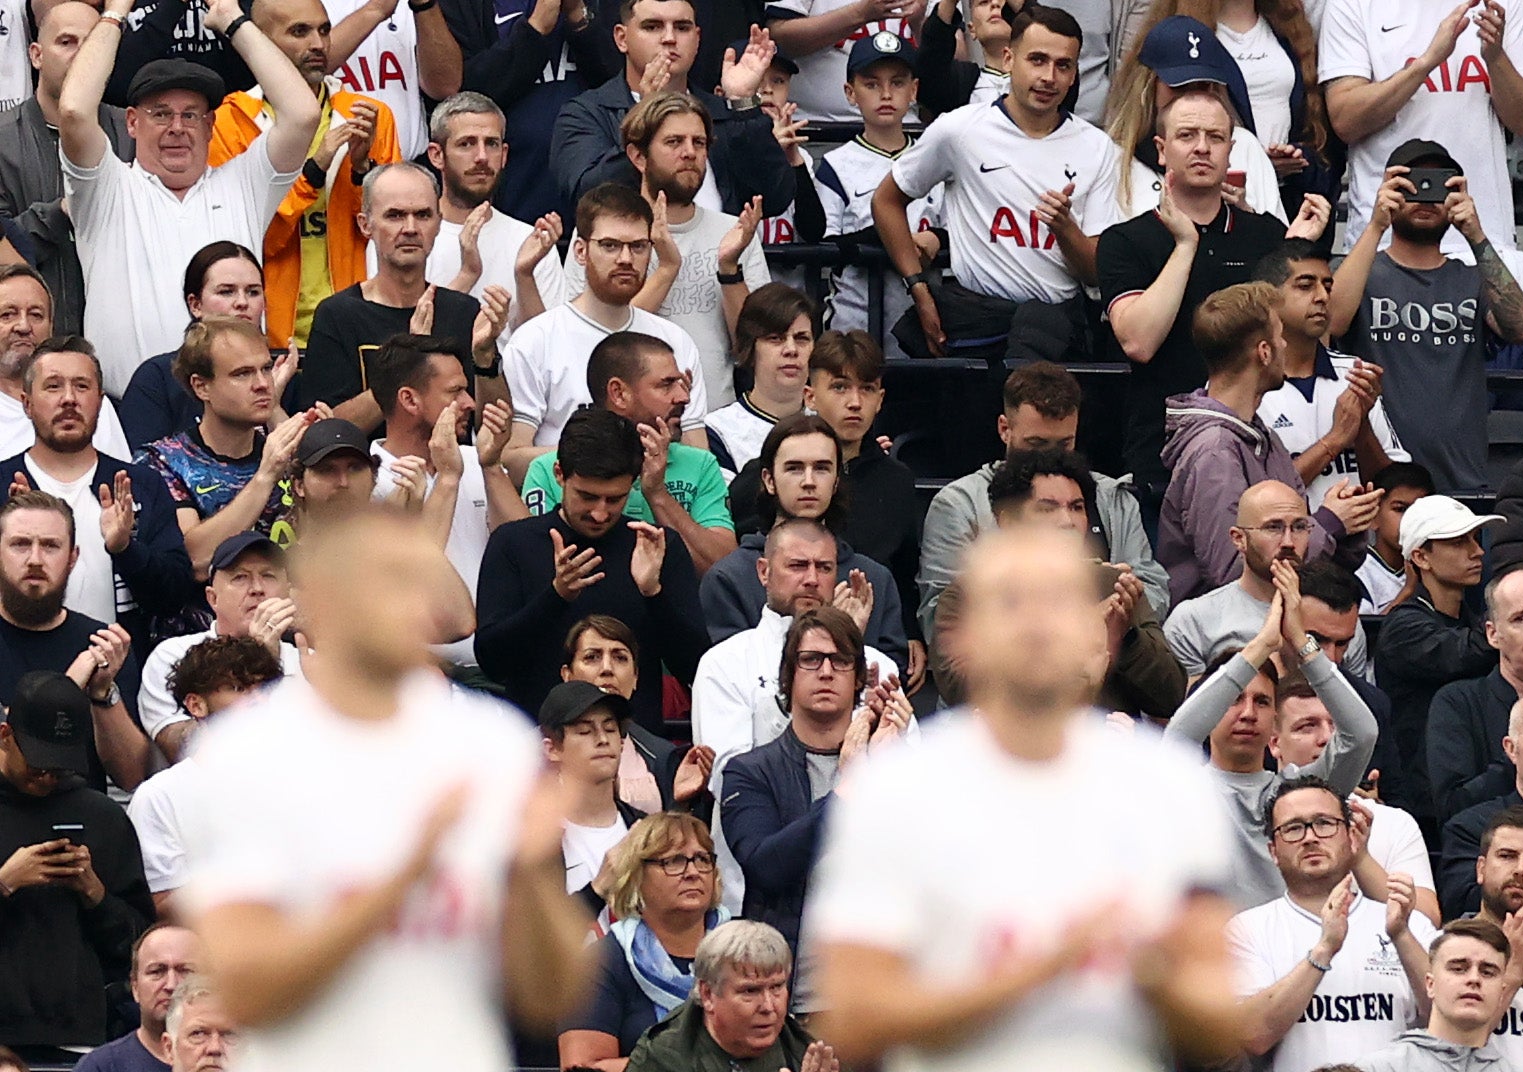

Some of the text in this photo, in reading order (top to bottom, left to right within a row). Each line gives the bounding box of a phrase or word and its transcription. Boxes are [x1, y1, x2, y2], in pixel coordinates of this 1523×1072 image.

[762, 218, 795, 244] IA
[1369, 297, 1478, 334] BOSS
[1371, 332, 1421, 343] HUGO
[1297, 992, 1394, 1023] OLSTEN
